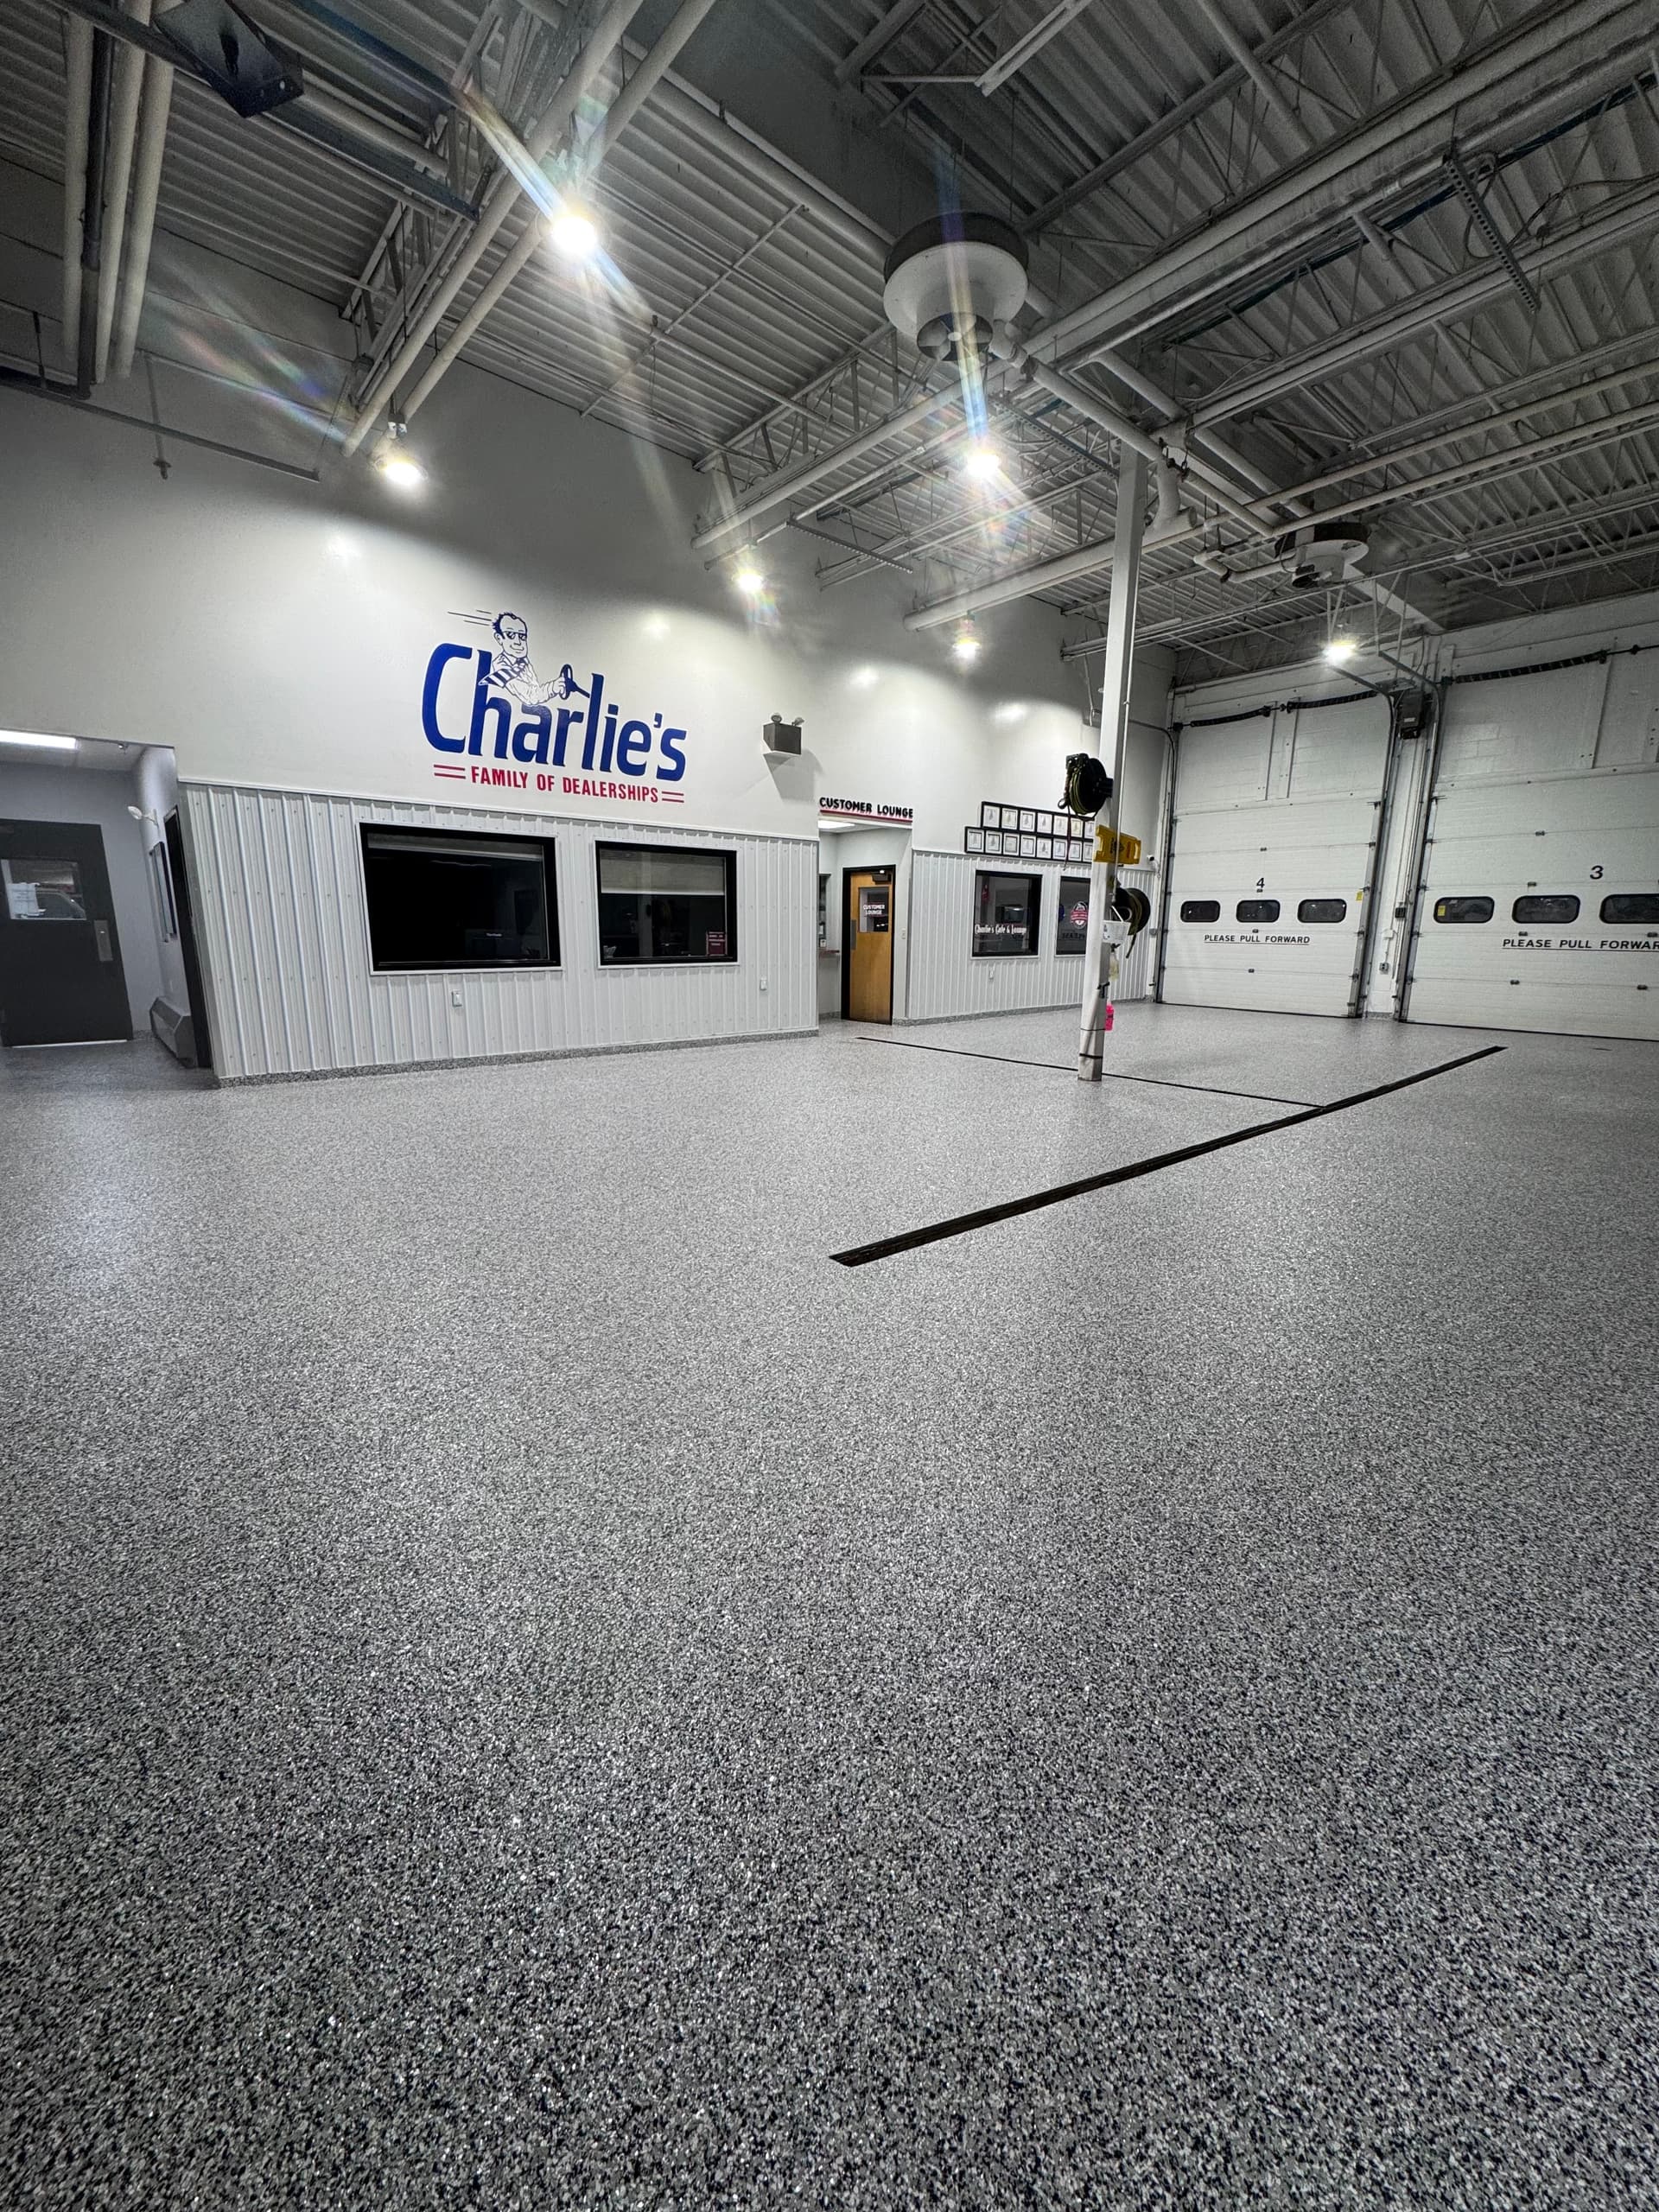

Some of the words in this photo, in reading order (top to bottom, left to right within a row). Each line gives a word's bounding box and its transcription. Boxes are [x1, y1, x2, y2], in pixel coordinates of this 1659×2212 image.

[422, 643, 688, 782] Charlie's
[471, 766, 528, 789] FAMILY
[537, 773, 555, 791] OF
[563, 777, 658, 802] DEALERSHIPS
[819, 797, 872, 813] CUSTOMER
[877, 804, 913, 818] LOUNGE
[1590, 865, 1604, 880] 3
[1256, 877, 1265, 888] 4
[1503, 939, 1552, 948] PLEASE
[1560, 940, 1592, 949] PULL
